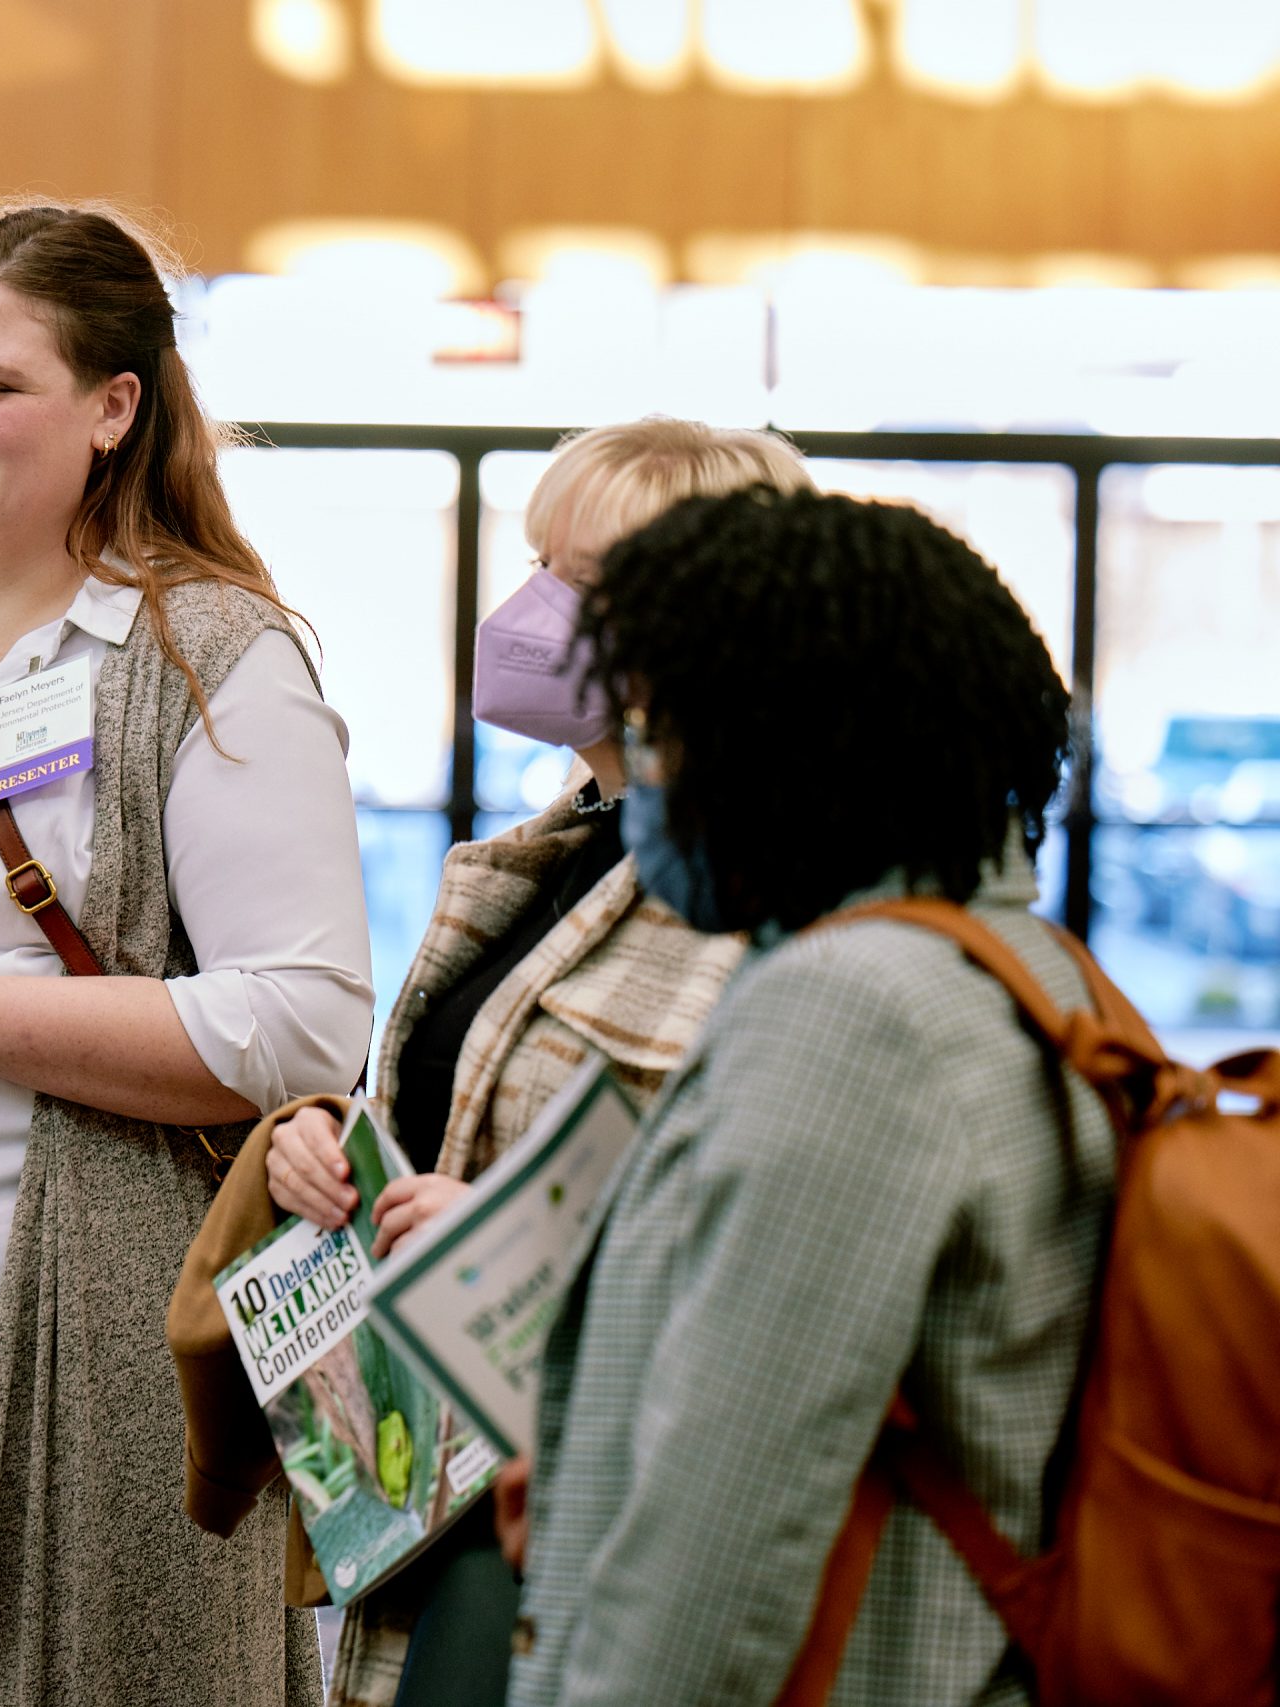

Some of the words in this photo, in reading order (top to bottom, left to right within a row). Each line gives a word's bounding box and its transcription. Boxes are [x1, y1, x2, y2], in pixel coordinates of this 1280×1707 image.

[0, 689, 29, 705] Faelyn
[31, 676, 65, 691] Meyers
[0, 706, 24, 720] Jersey
[26, 687, 74, 709] Department
[75, 683, 84, 692] of
[41, 695, 82, 714] Protection
[243, 1247, 362, 1360] WETLANDS
